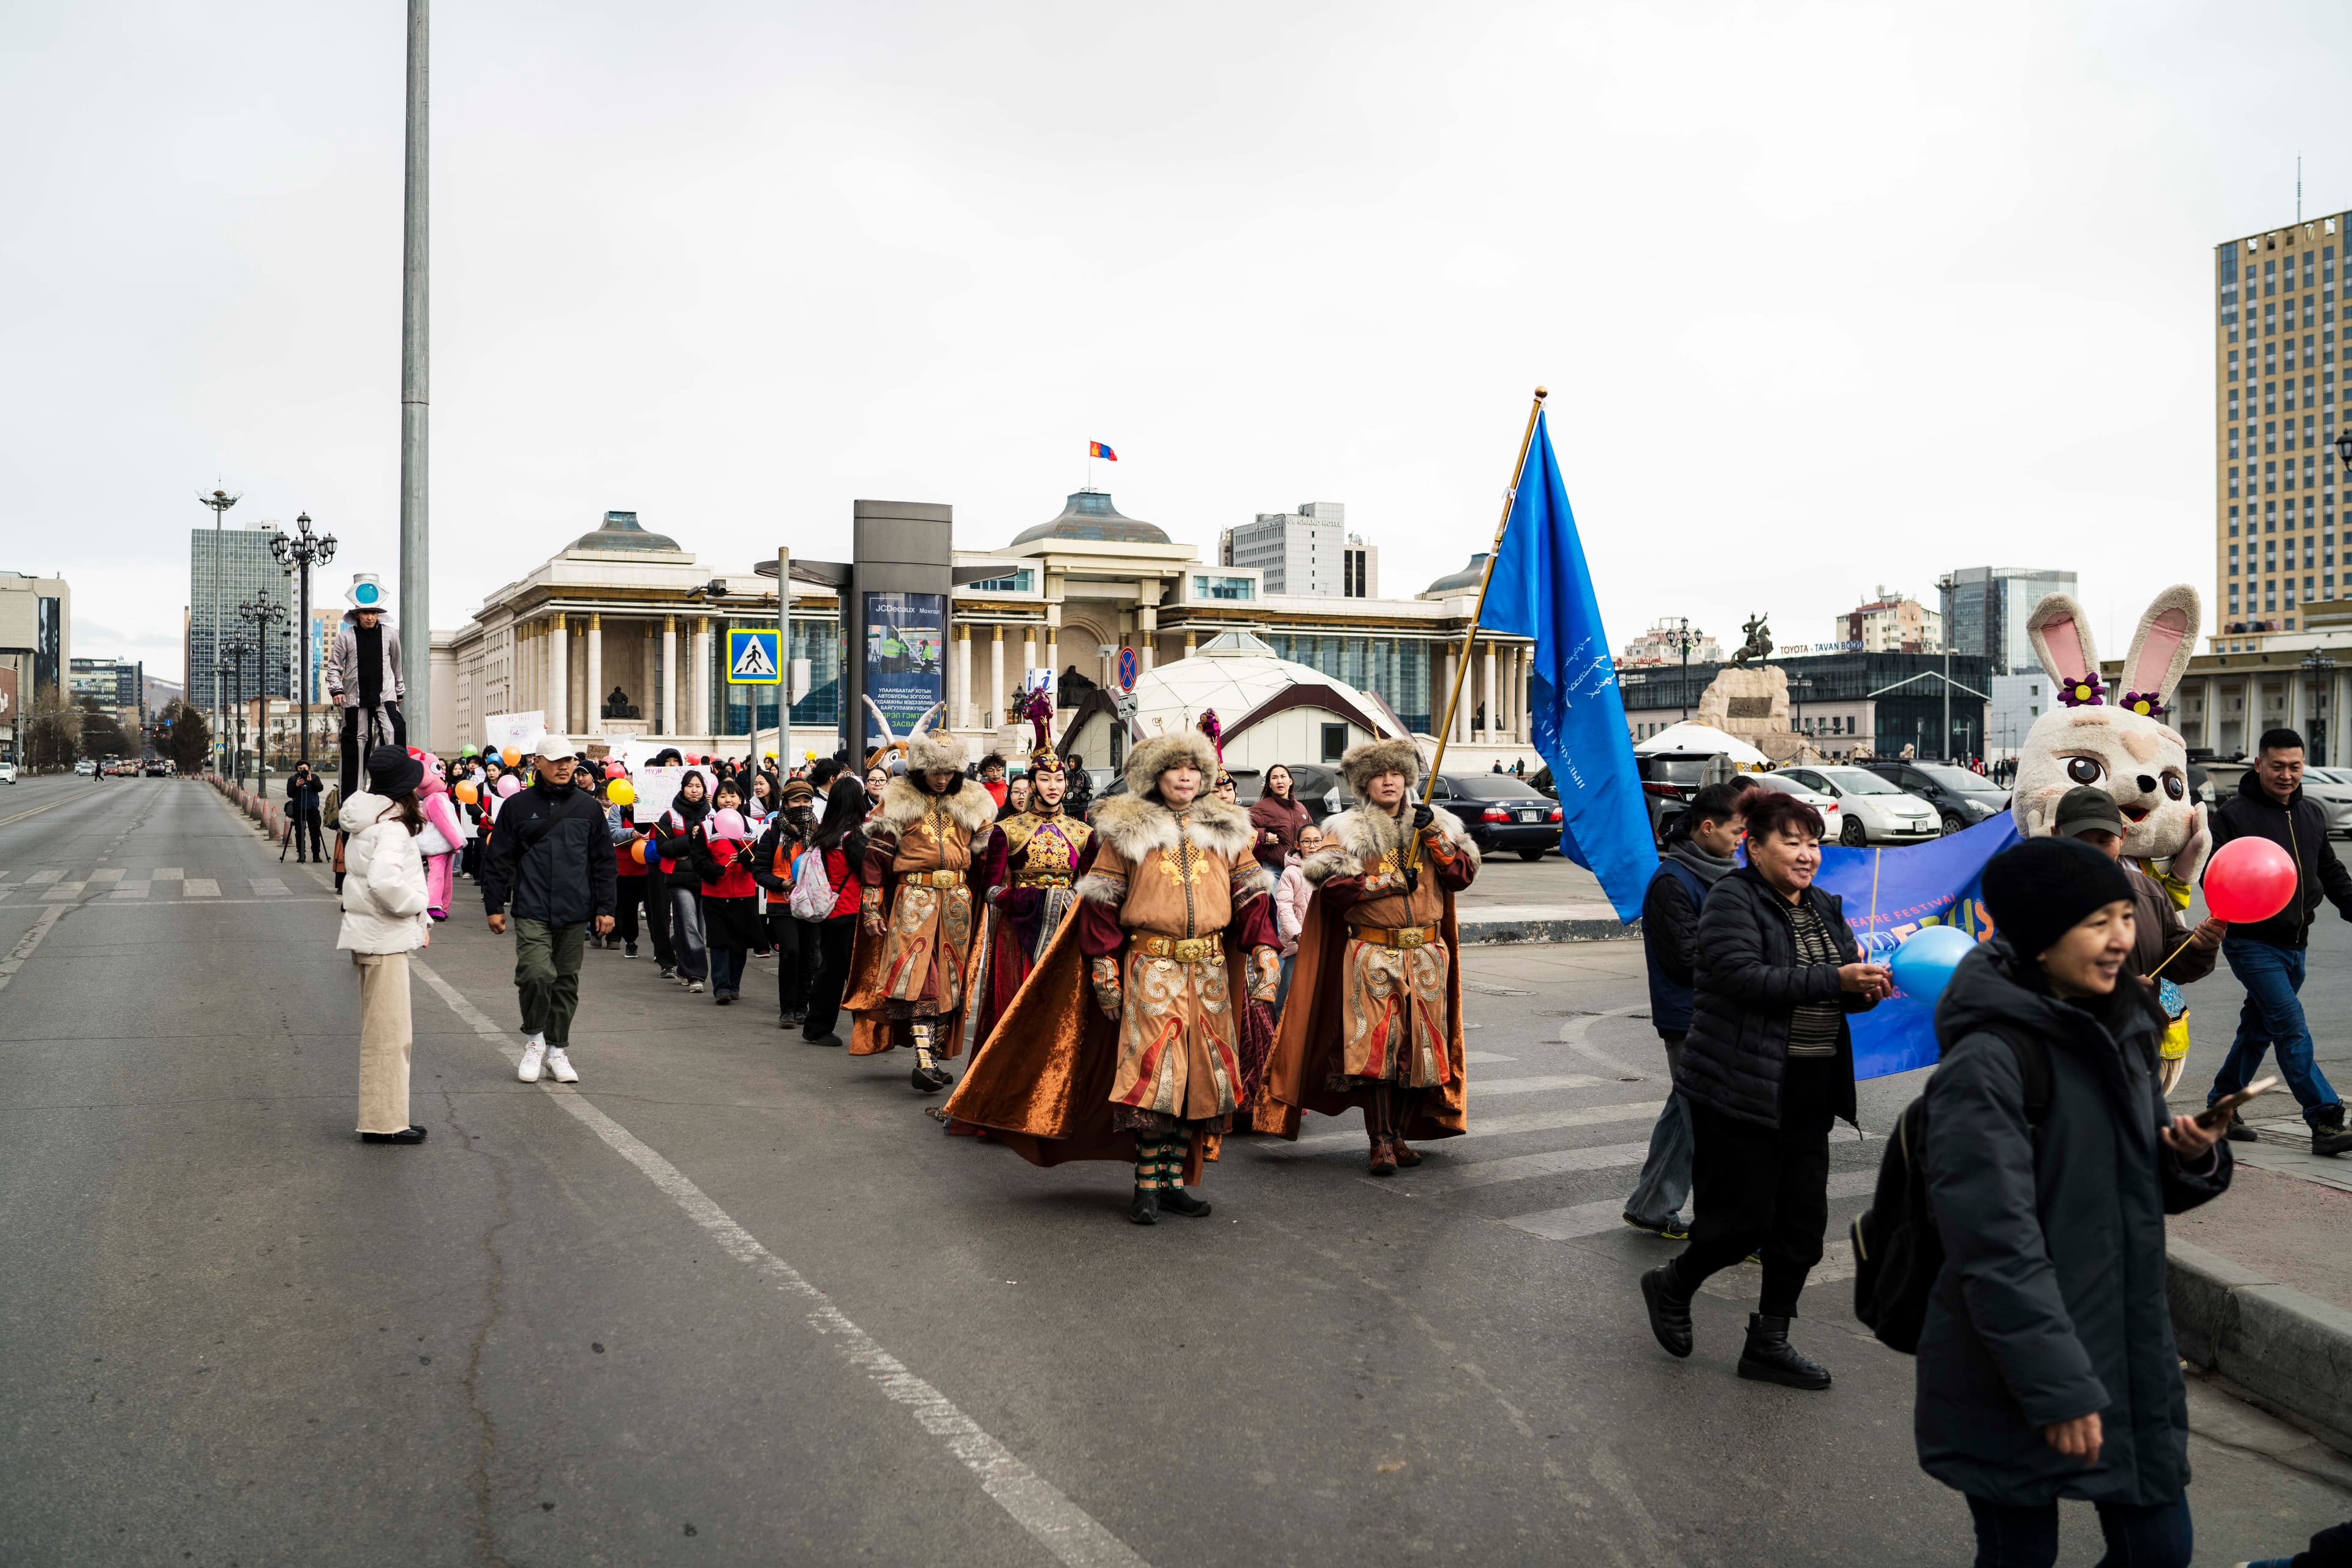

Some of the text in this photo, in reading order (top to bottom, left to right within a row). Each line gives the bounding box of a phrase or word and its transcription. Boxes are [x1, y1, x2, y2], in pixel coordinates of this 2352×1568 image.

[876, 605, 915, 613] JCDecaux
[1780, 645, 1808, 654] TOYOTA
[1815, 642, 1839, 652] TAVAN
